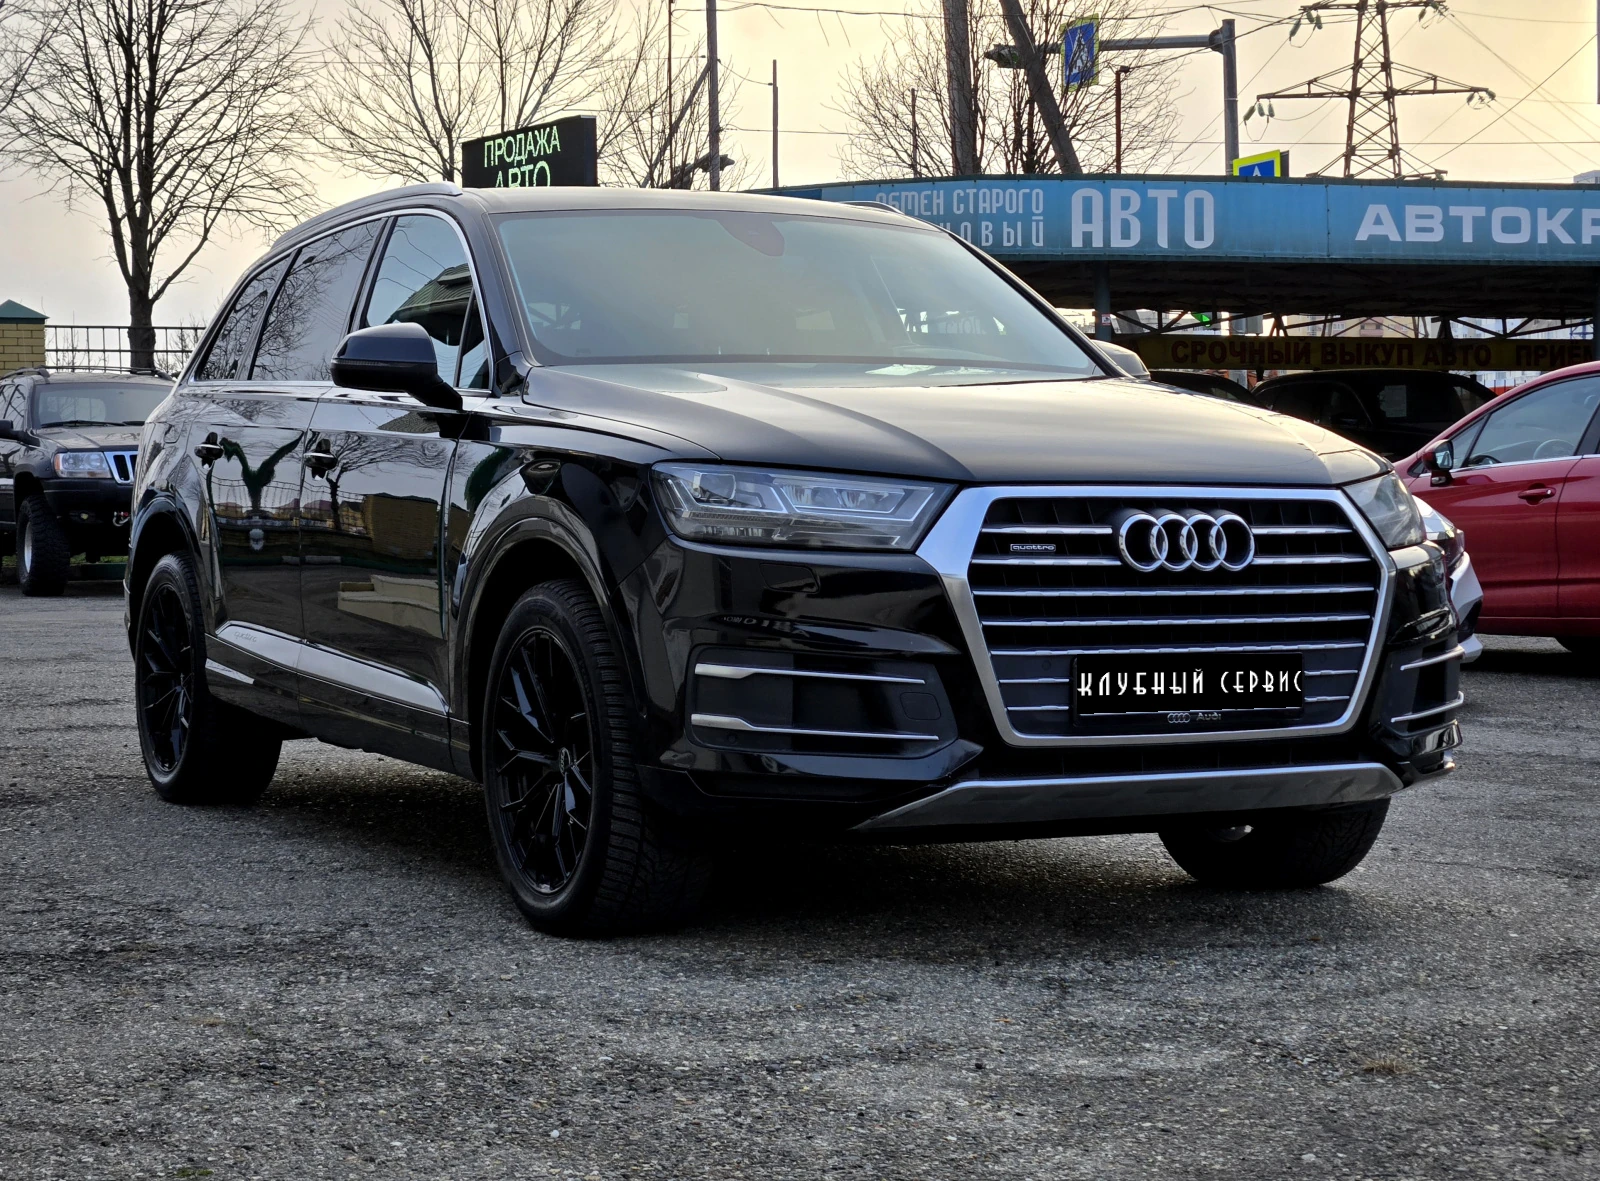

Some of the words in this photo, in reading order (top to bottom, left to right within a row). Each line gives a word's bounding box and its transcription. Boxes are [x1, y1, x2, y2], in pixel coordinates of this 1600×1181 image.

[484, 125, 561, 168] ПРОДАЖА
[952, 188, 1044, 215] СТАРОГО
[940, 216, 1044, 247] ОВЫЙ
[1071, 188, 1215, 249] АВТО
[1171, 337, 1311, 364] СРОЧНЫЙ
[1321, 343, 1414, 366] ВЫКУП
[1423, 344, 1491, 367] АВТО
[1077, 669, 1204, 696] КЛУБНЫЙ
[1221, 670, 1302, 693] СЕРВИС
[1196, 712, 1222, 720] Audi
